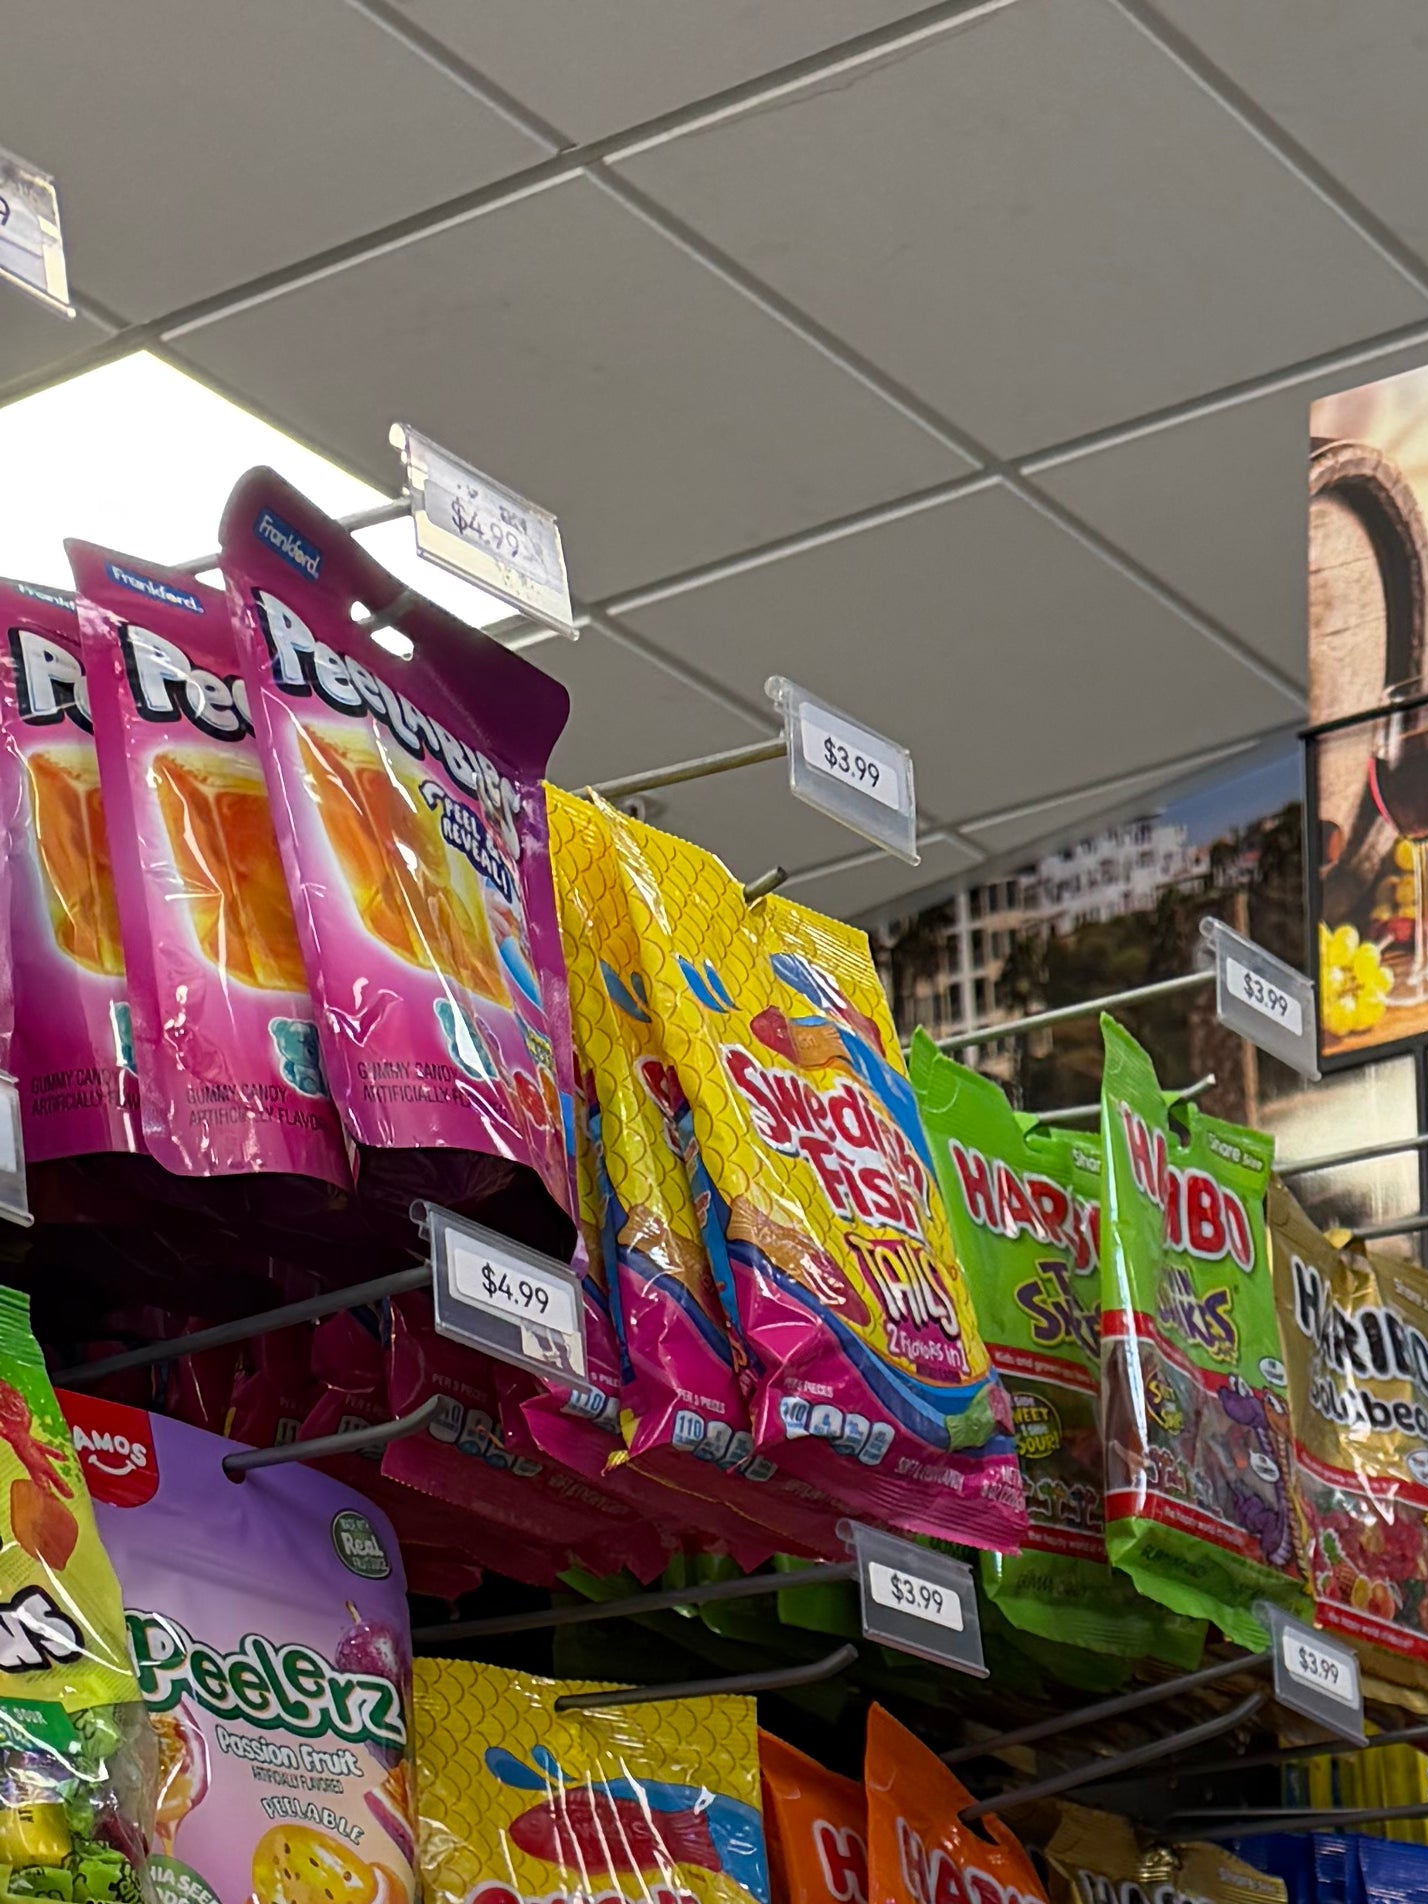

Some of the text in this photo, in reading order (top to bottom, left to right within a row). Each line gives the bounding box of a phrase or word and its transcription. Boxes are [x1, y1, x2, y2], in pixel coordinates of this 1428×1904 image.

[450, 496, 522, 562] $4.99
[823, 736, 880, 789] $3.99
[1244, 971, 1289, 1017] $3.99
[724, 1044, 932, 1219] Swedish
[800, 1139, 924, 1240] Fish
[481, 1260, 550, 1315] $4.99
[72, 1424, 147, 1468] AMOS
[890, 1576, 945, 1614] $3.99
[122, 1606, 410, 1753] Peelerz
[1298, 1645, 1340, 1685] $3.99
[215, 1723, 365, 1778] Passion Fruit
[261, 1795, 366, 1846] PEELABLE
